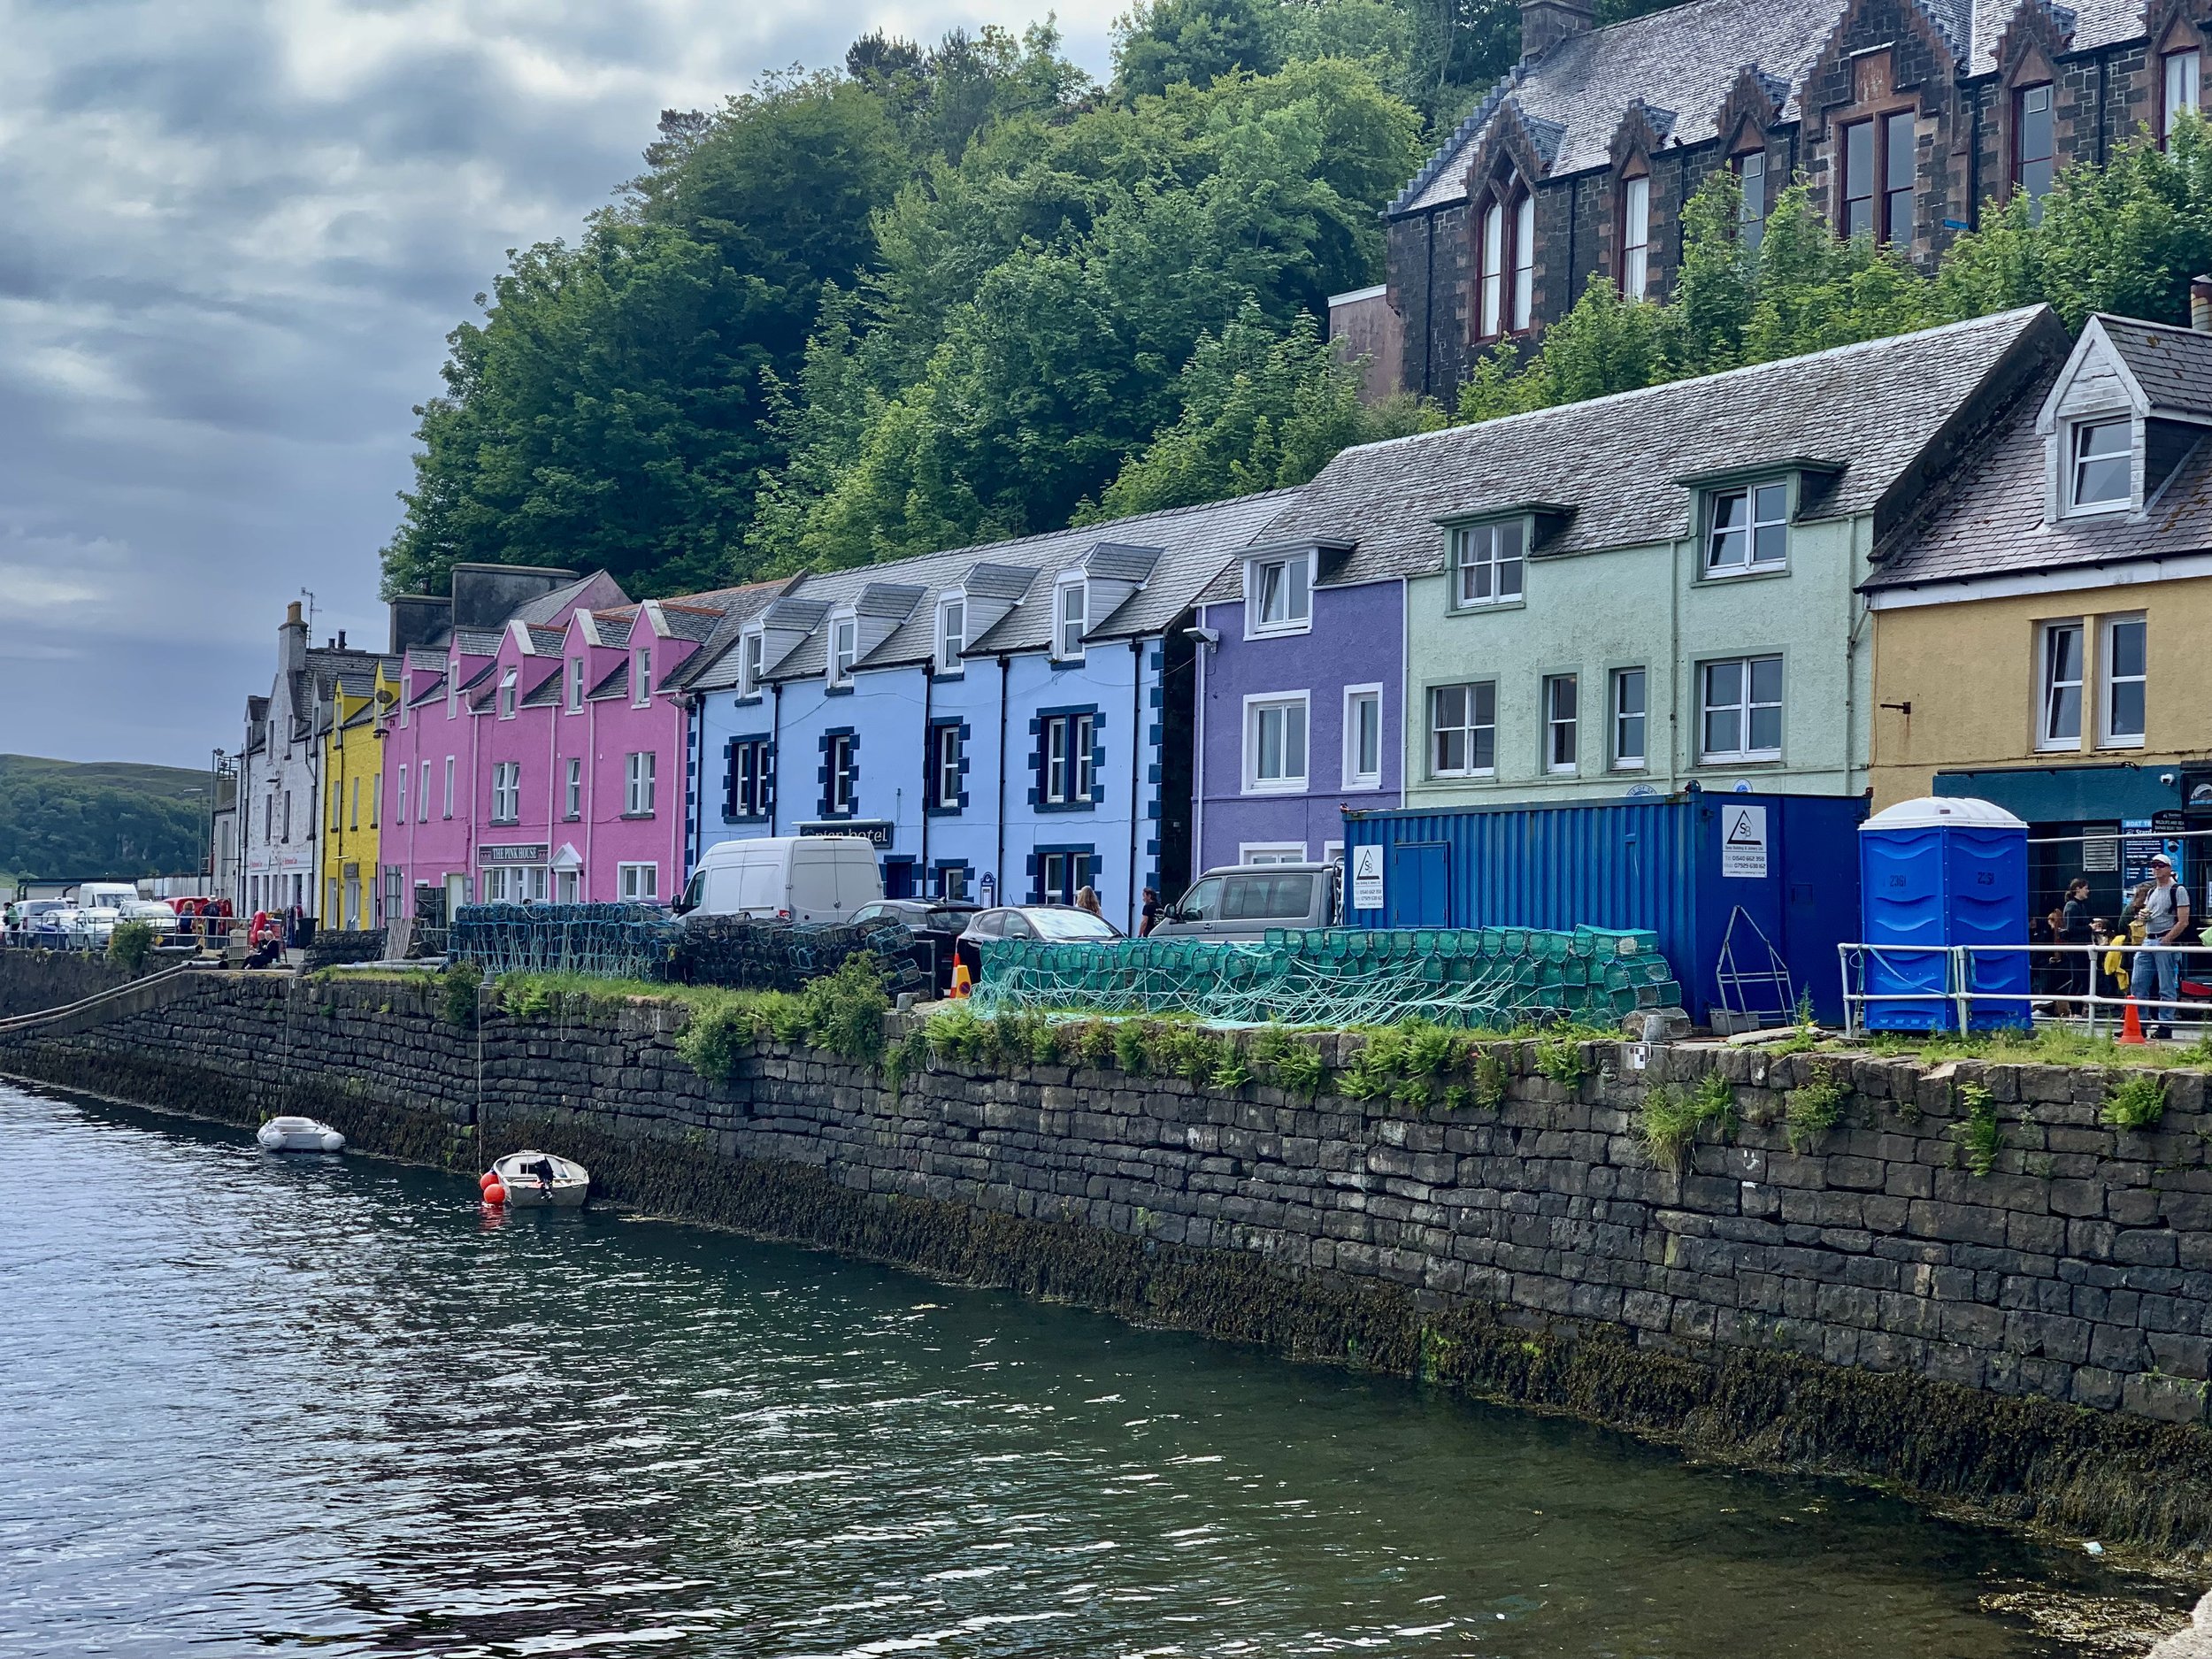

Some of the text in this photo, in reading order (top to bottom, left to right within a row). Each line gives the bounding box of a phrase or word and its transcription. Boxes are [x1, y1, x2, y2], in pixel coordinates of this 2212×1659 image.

[492, 847, 537, 860] THE PINK HOUSE
